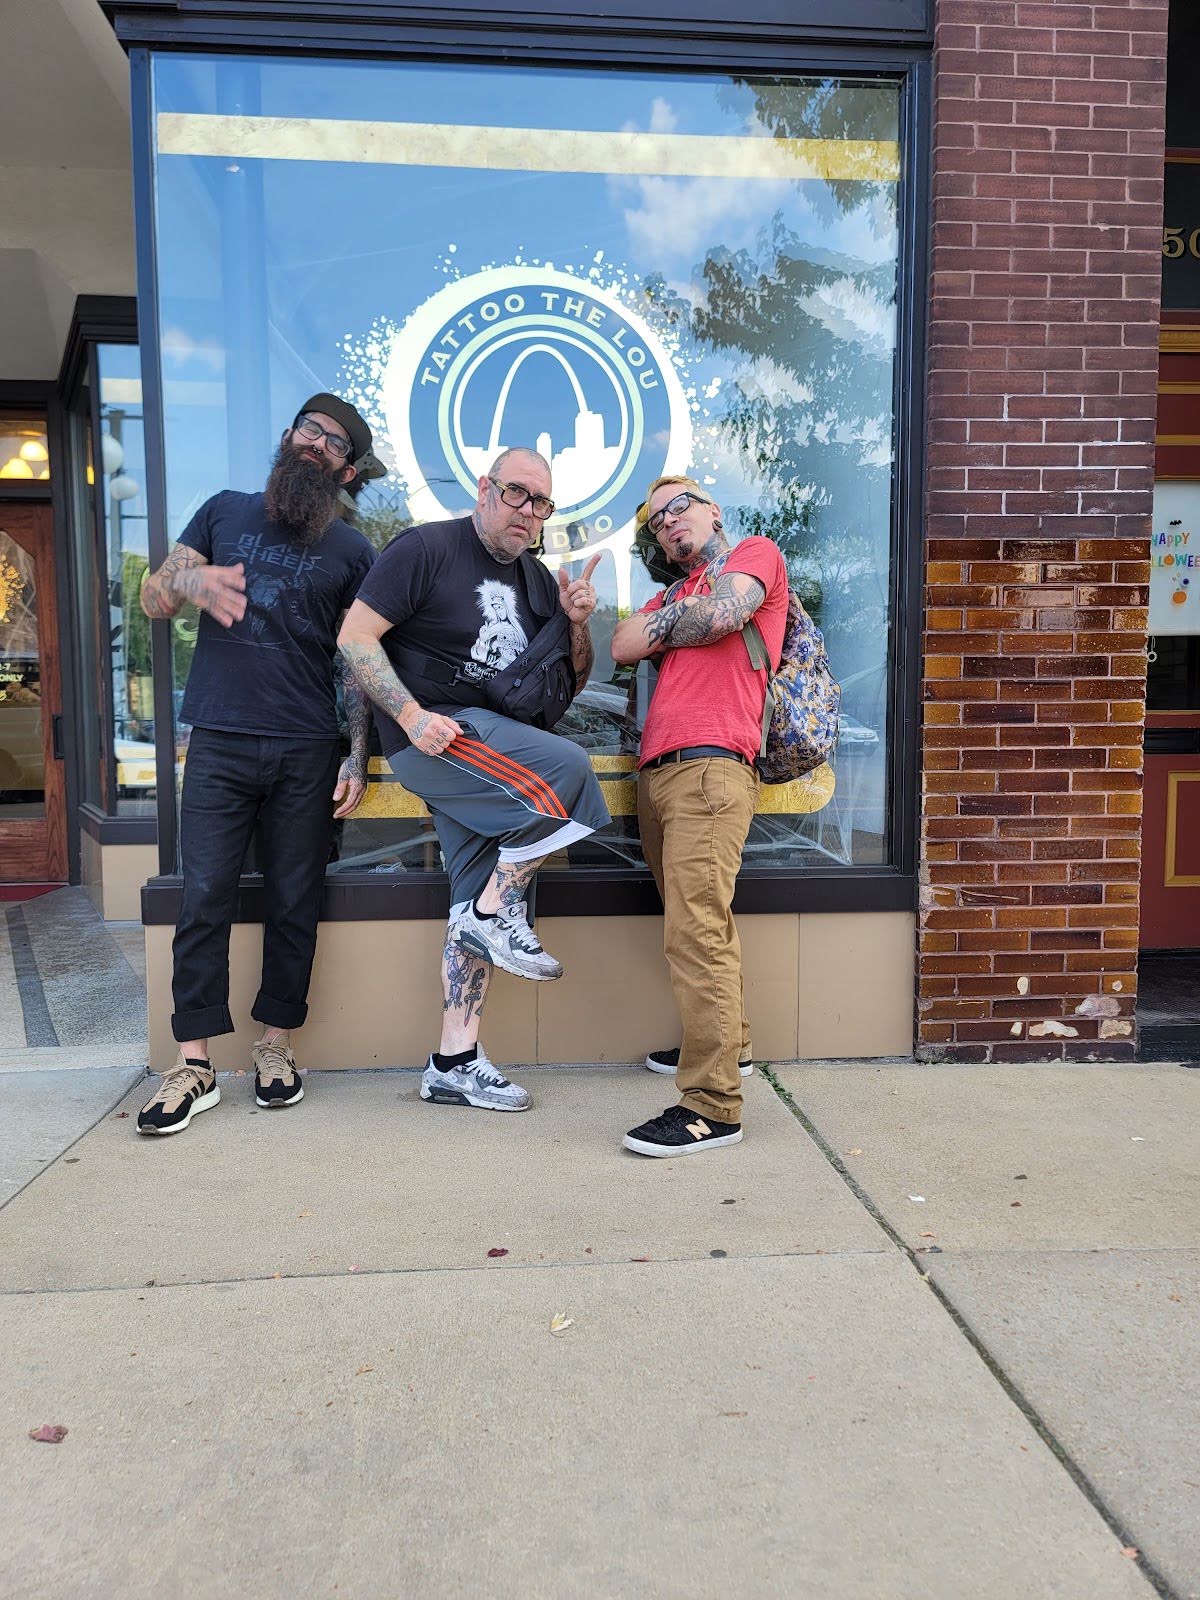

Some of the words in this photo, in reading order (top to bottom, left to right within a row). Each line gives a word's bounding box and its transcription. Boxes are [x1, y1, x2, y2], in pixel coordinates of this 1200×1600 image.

[420, 293, 525, 388] TATTOO
[541, 292, 626, 328] THE
[611, 327, 658, 390] LOU
